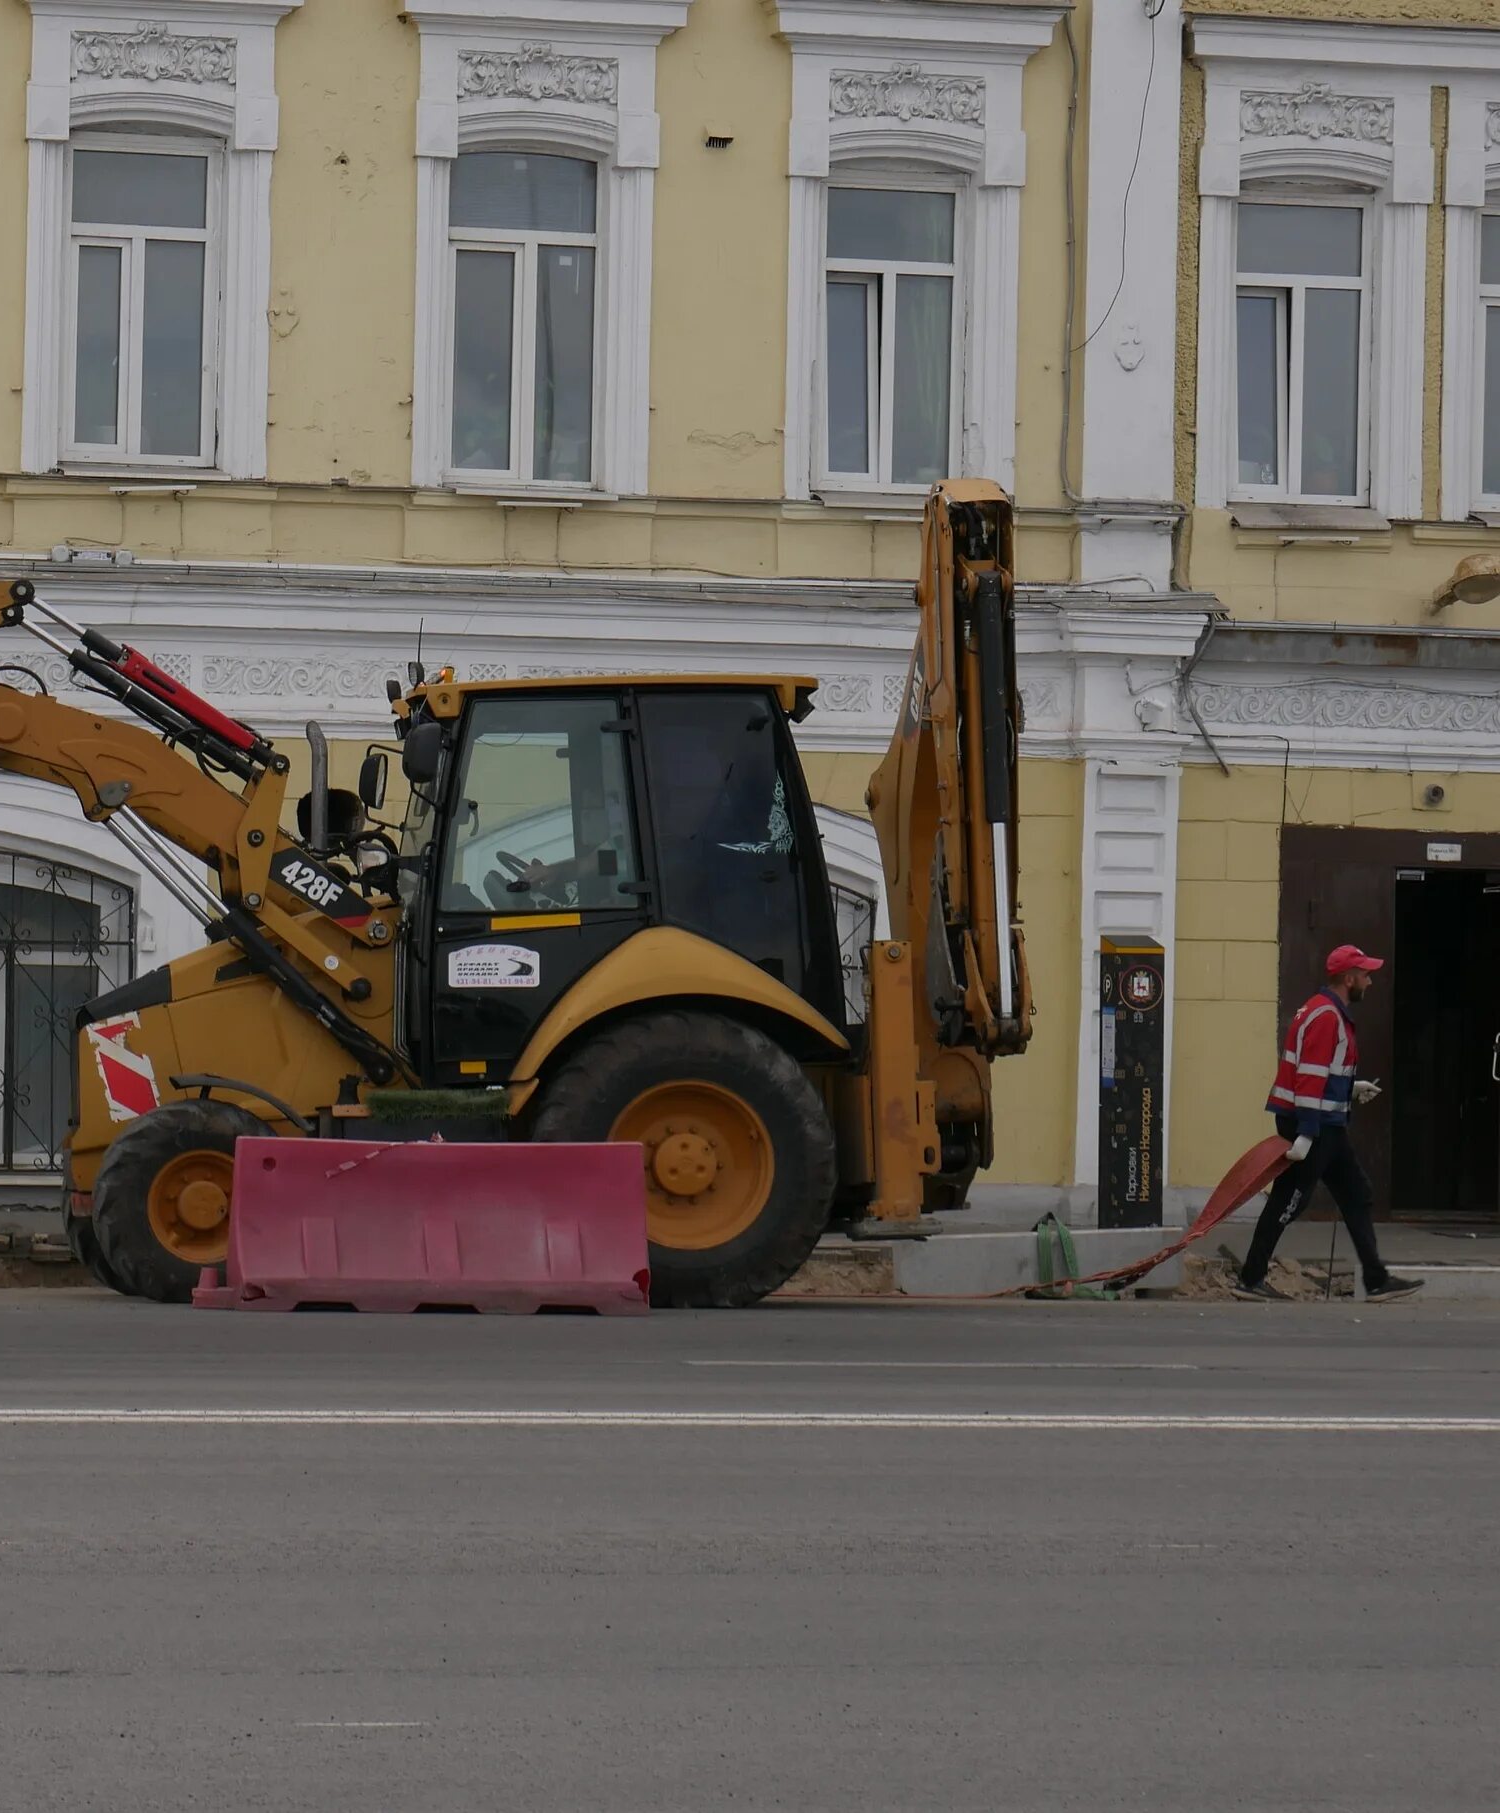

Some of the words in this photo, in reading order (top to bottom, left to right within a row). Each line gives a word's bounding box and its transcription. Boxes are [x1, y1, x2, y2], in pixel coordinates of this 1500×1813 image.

[281, 860, 344, 907] 428F
[1140, 1087, 1152, 1150] Новгорода
[1126, 1147, 1139, 1202] Парковки
[1139, 1151, 1150, 1202] Нижнего
